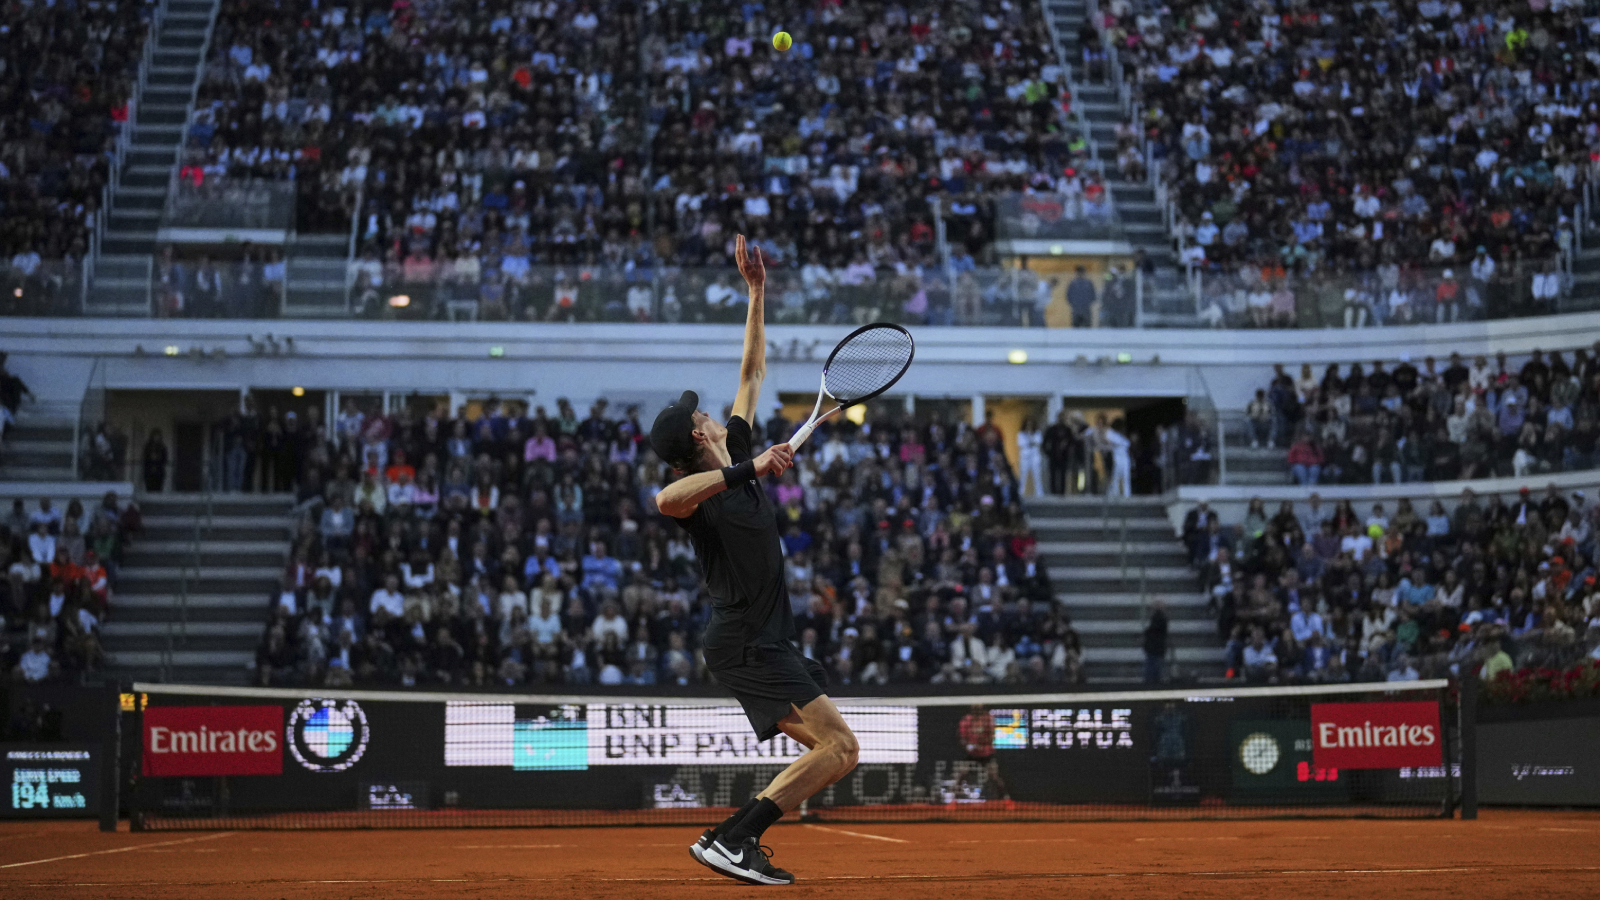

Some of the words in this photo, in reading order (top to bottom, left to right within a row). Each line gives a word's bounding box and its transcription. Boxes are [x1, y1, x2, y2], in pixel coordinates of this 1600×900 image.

[1031, 708, 1132, 730] REALE
[150, 725, 277, 753] Emirates
[1318, 720, 1436, 748] Emirates
[12, 782, 50, 808] 194
